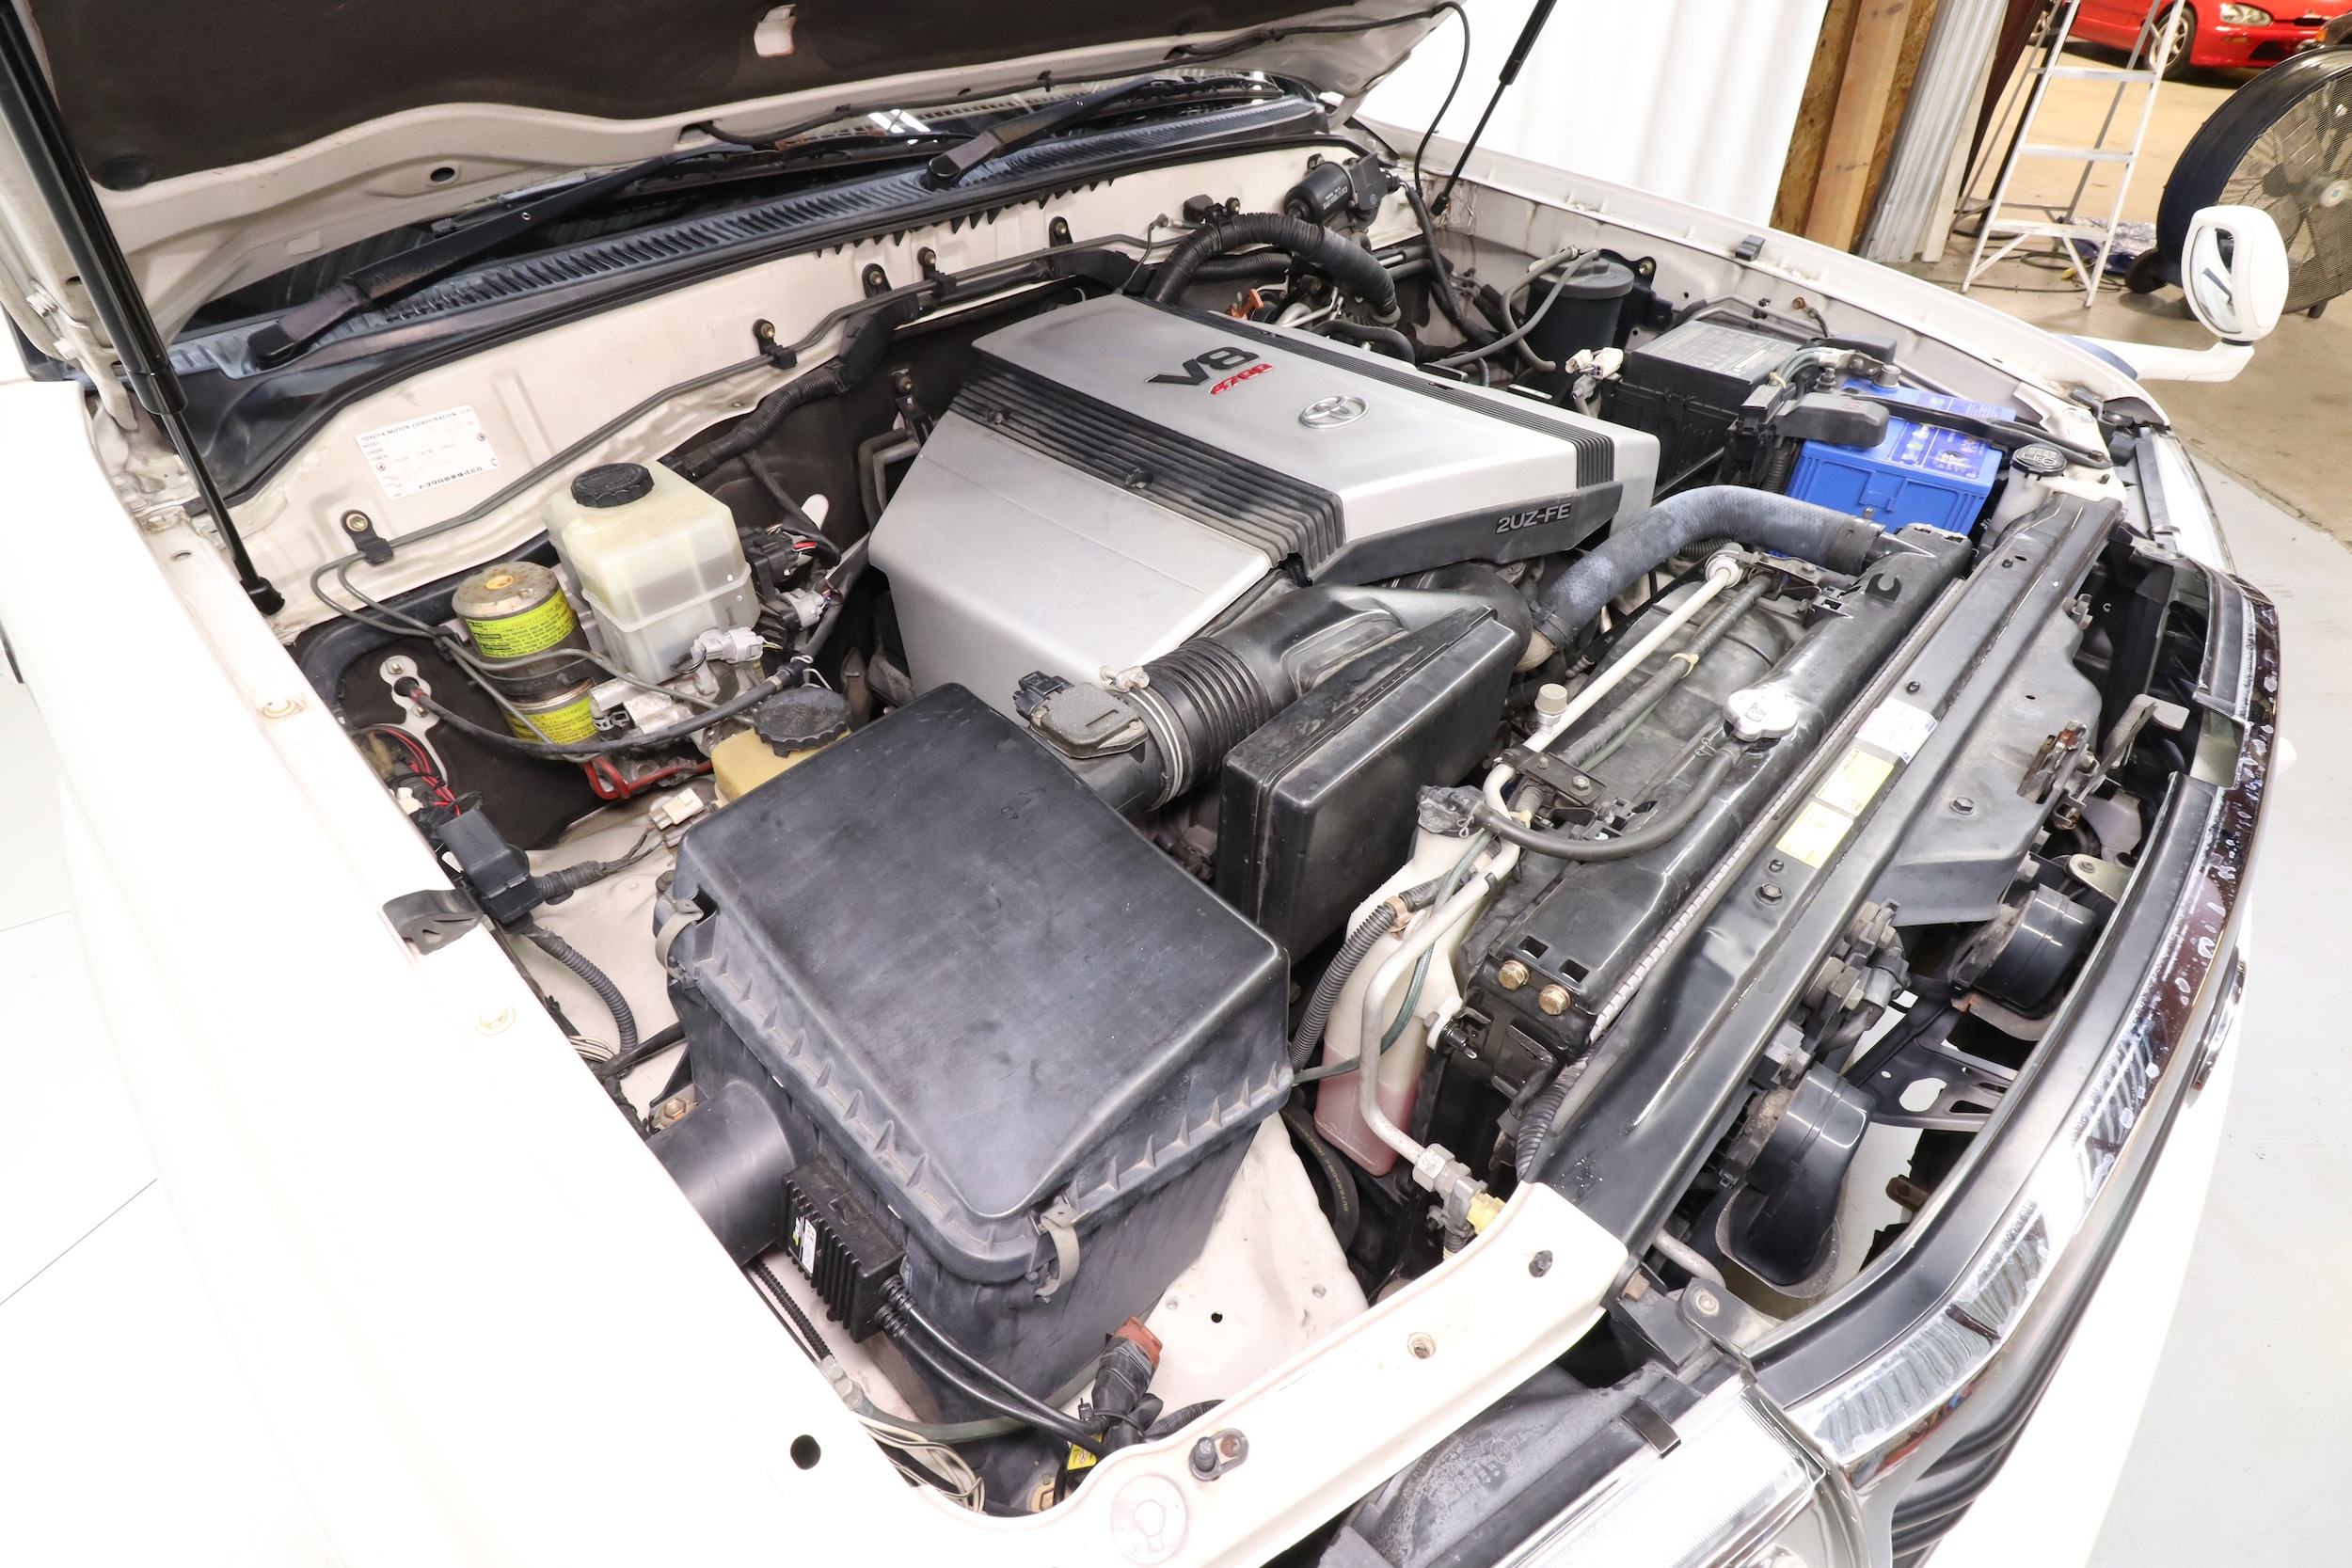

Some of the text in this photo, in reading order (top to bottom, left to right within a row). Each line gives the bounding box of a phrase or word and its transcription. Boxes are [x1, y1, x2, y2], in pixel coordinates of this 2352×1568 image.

[1146, 346, 1261, 386] V8
[1209, 363, 1275, 394] 4700
[361, 433, 386, 442] TOYOTA
[387, 425, 410, 435] MOTOR
[411, 412, 457, 428] CORPORATION
[1496, 503, 1571, 533] 2UZ-FE
